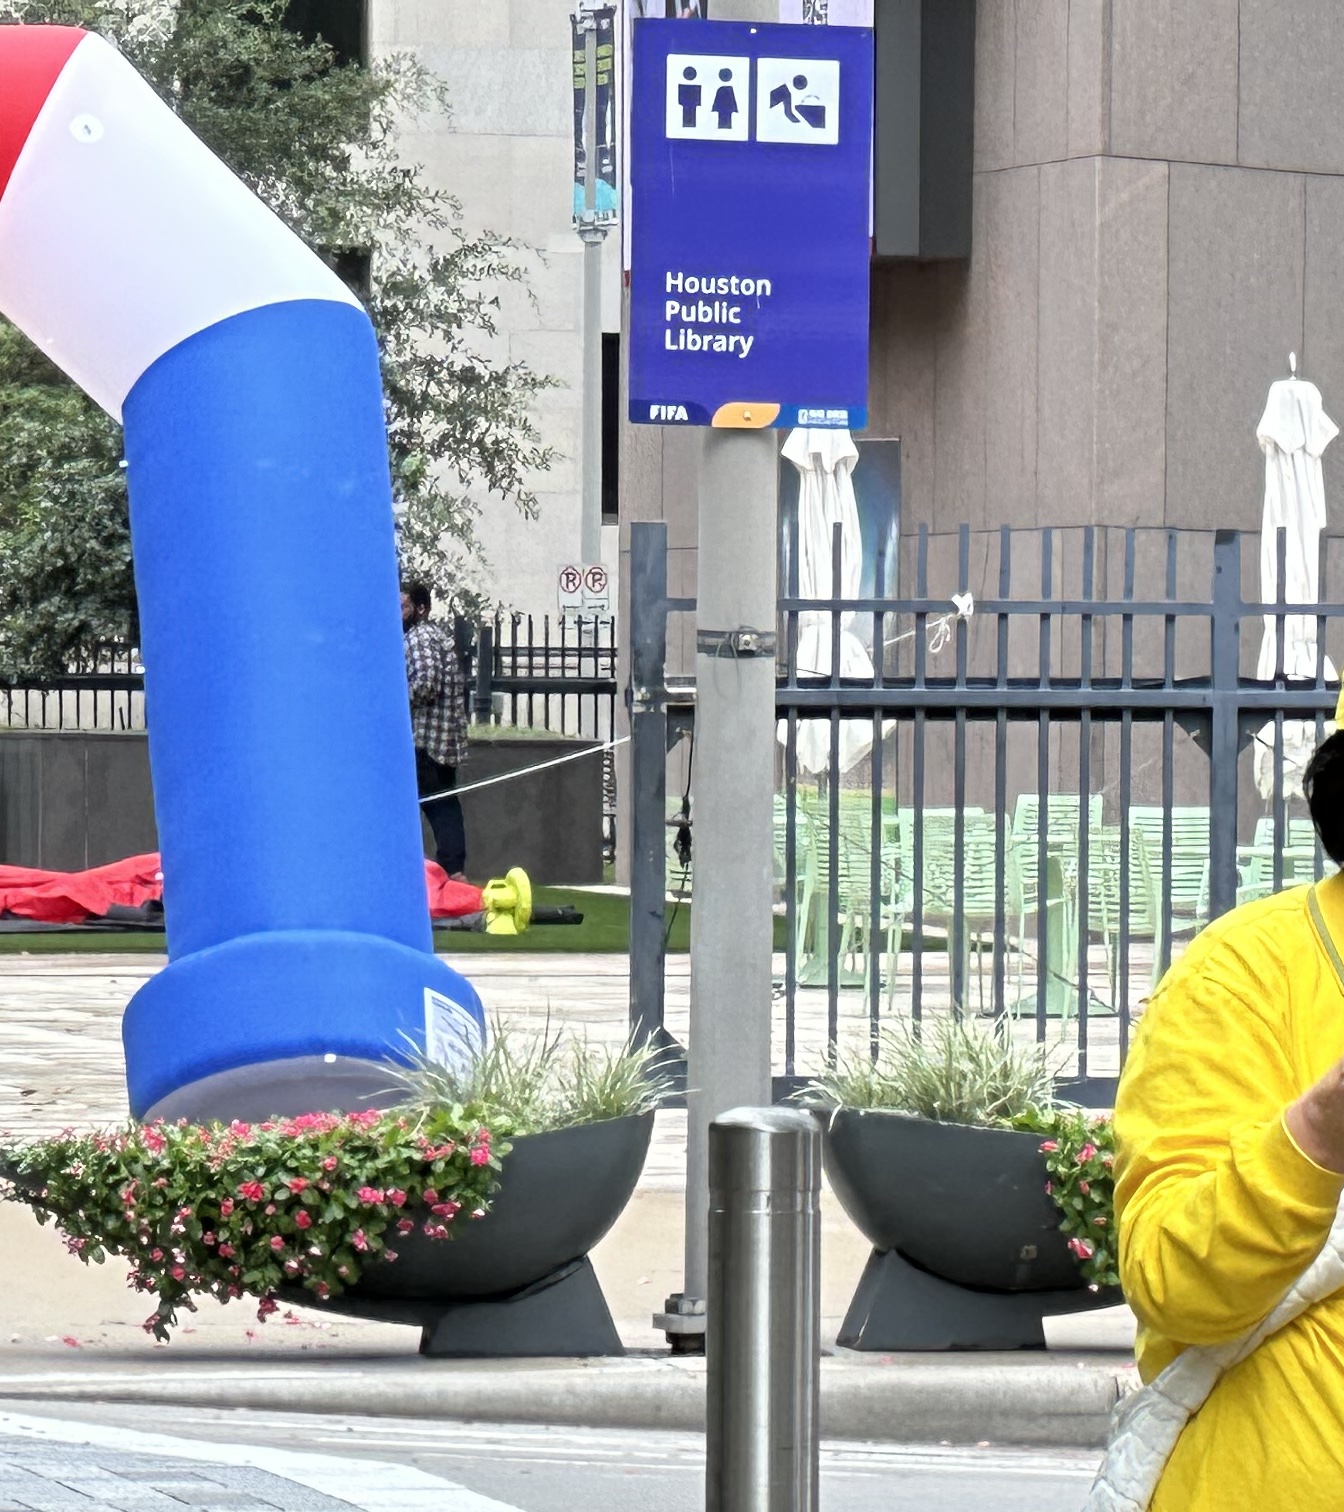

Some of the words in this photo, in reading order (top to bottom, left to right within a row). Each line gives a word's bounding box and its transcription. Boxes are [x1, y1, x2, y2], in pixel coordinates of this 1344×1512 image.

[665, 271, 772, 297] Houston
[665, 299, 742, 324] Public
[664, 328, 755, 359] Library
[649, 404, 688, 421] FIFA
